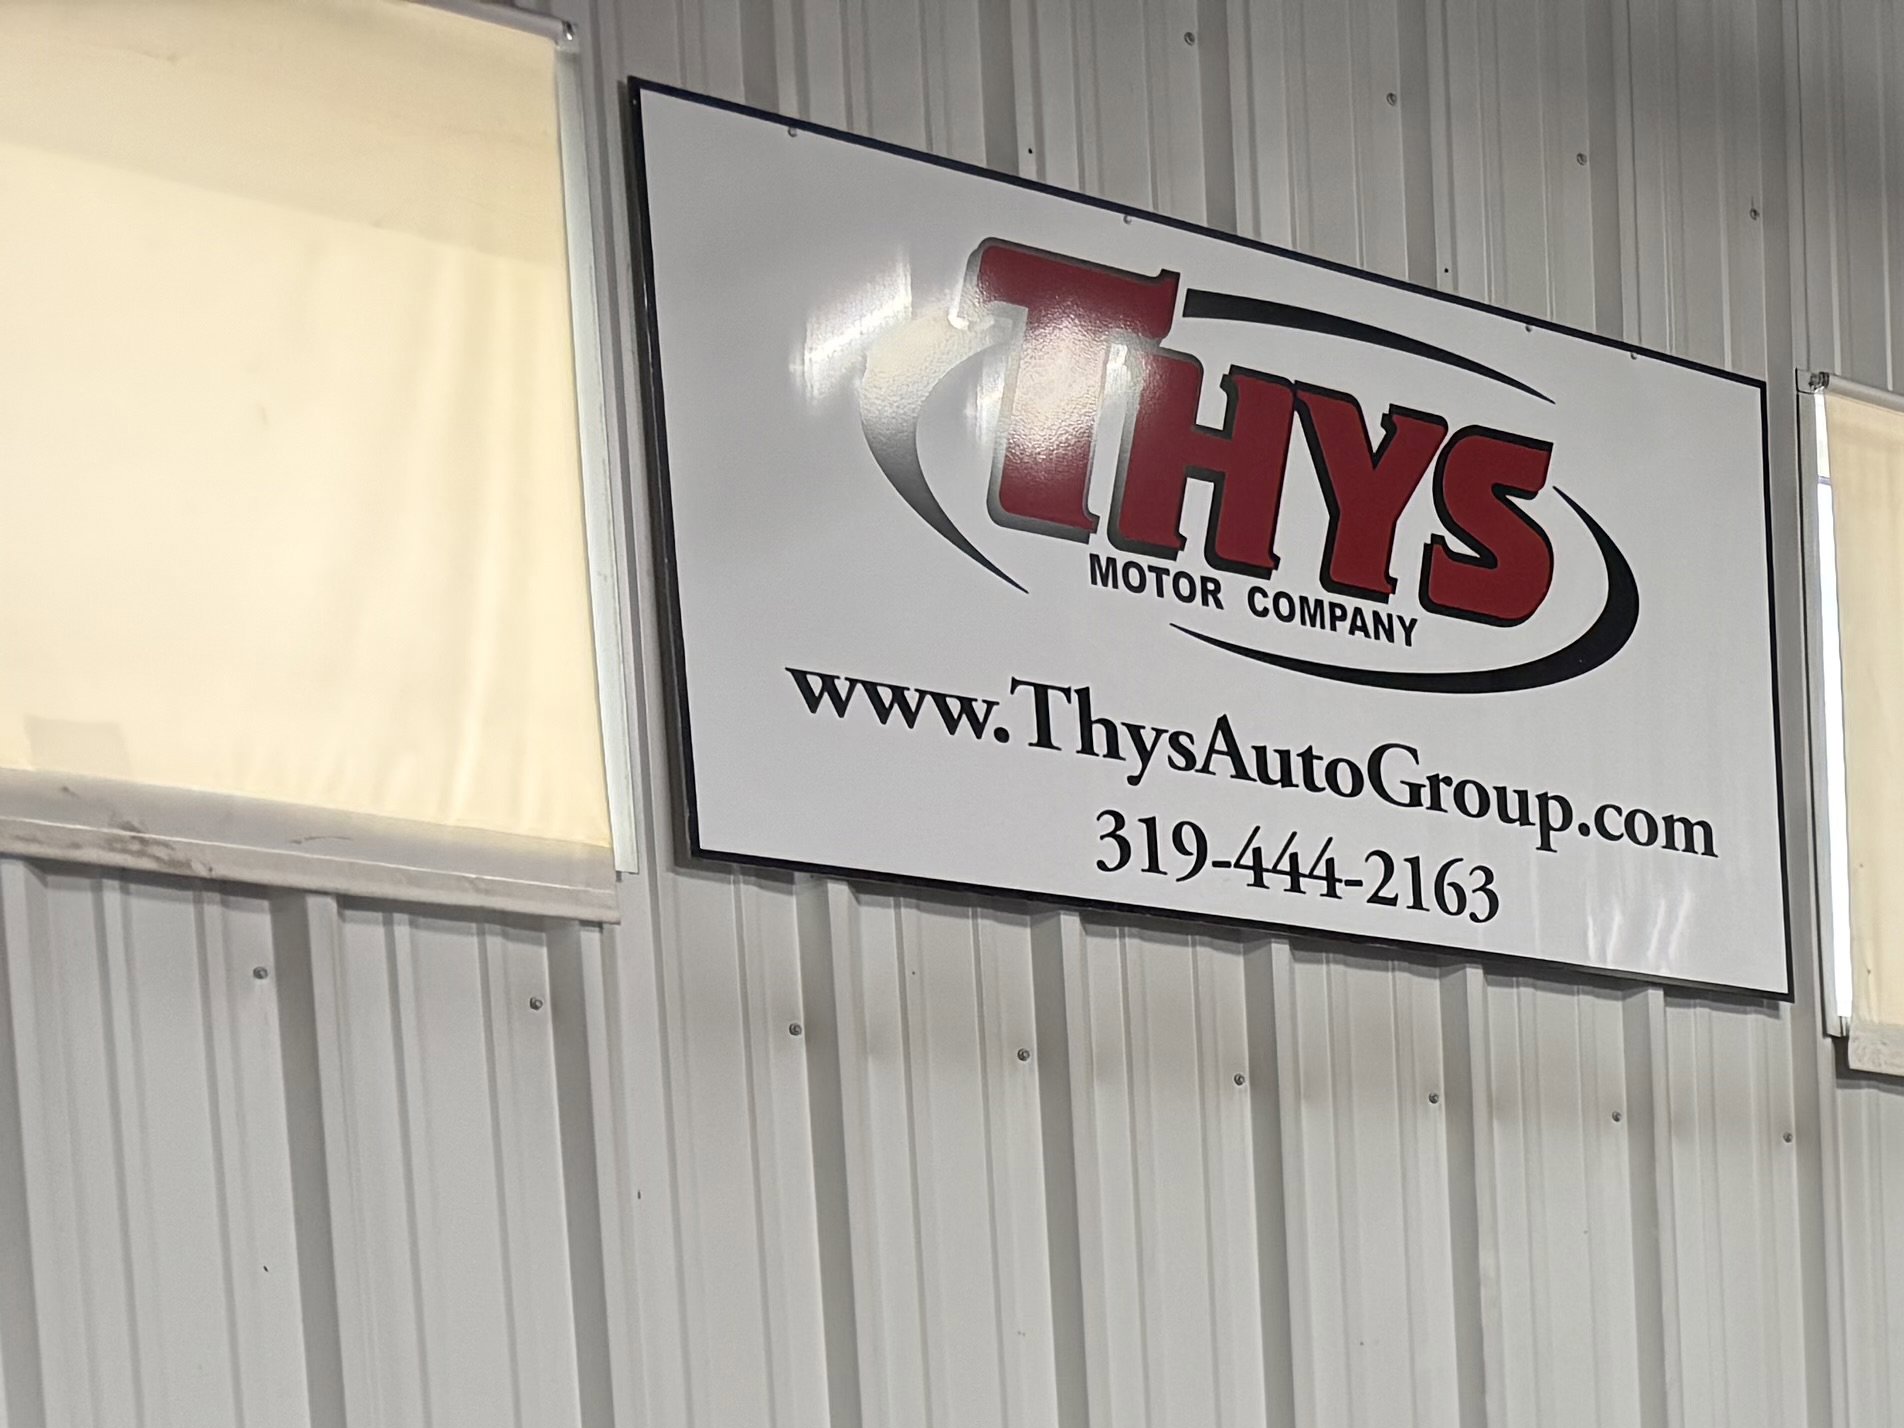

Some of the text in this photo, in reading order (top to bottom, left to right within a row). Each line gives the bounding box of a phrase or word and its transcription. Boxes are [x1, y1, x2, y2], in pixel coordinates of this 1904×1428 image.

[959, 236, 1555, 628] THYS
[1089, 553, 1418, 647] MOTOR COMPANY
[785, 667, 1718, 859] www.ThysAutoGroup.com
[1095, 809, 1501, 924] 319-444-2163
